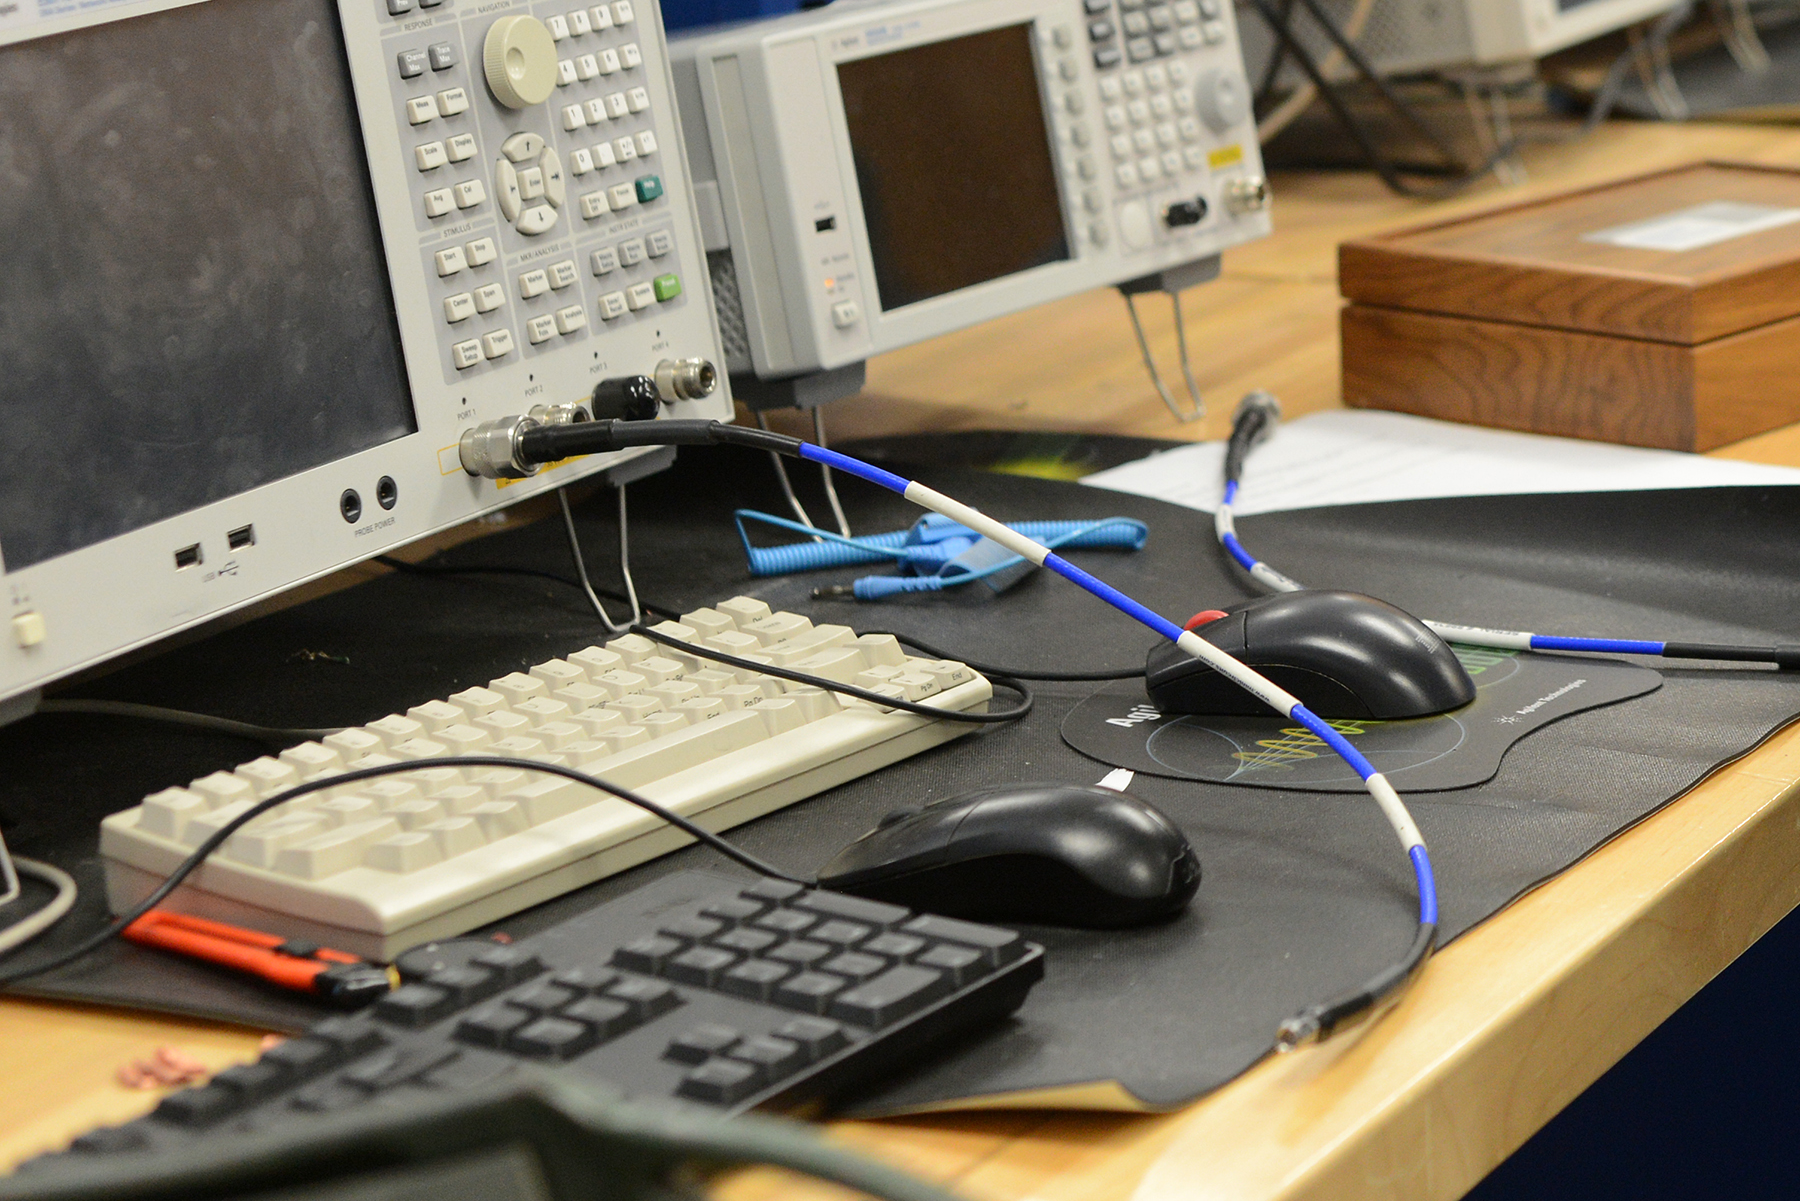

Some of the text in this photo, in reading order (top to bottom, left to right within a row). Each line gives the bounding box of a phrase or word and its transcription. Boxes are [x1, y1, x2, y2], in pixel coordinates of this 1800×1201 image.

[478, 1, 510, 13] NAVIGATION
[404, 18, 433, 30] RESPONSE
[406, 52, 426, 63] Channel
[446, 92, 463, 101] Format
[455, 138, 472, 148] Display
[424, 146, 438, 155] Scale
[433, 194, 444, 202] Avg
[443, 223, 472, 238] STIMULUS
[475, 244, 486, 252] Stop
[519, 244, 560, 261] MKR/ANALYSIS
[444, 252, 457, 261] Start
[556, 265, 572, 274] Marker
[527, 274, 543, 283] Marker
[559, 273, 576, 282] Search
[483, 289, 496, 298] Span
[453, 298, 469, 307] Center
[564, 309, 583, 319] Analysis
[535, 319, 552, 328] Marker
[491, 334, 508, 344] Trigger
[461, 343, 478, 353] Sweep
[464, 352, 478, 361] Setup
[590, 365, 602, 374] PORT
[524, 387, 538, 397] PORT
[457, 410, 471, 421] PORT
[355, 517, 396, 538] PROBE POWER
[951, 672, 964, 681] End
[1515, 679, 1587, 715] Agilent Technologies
